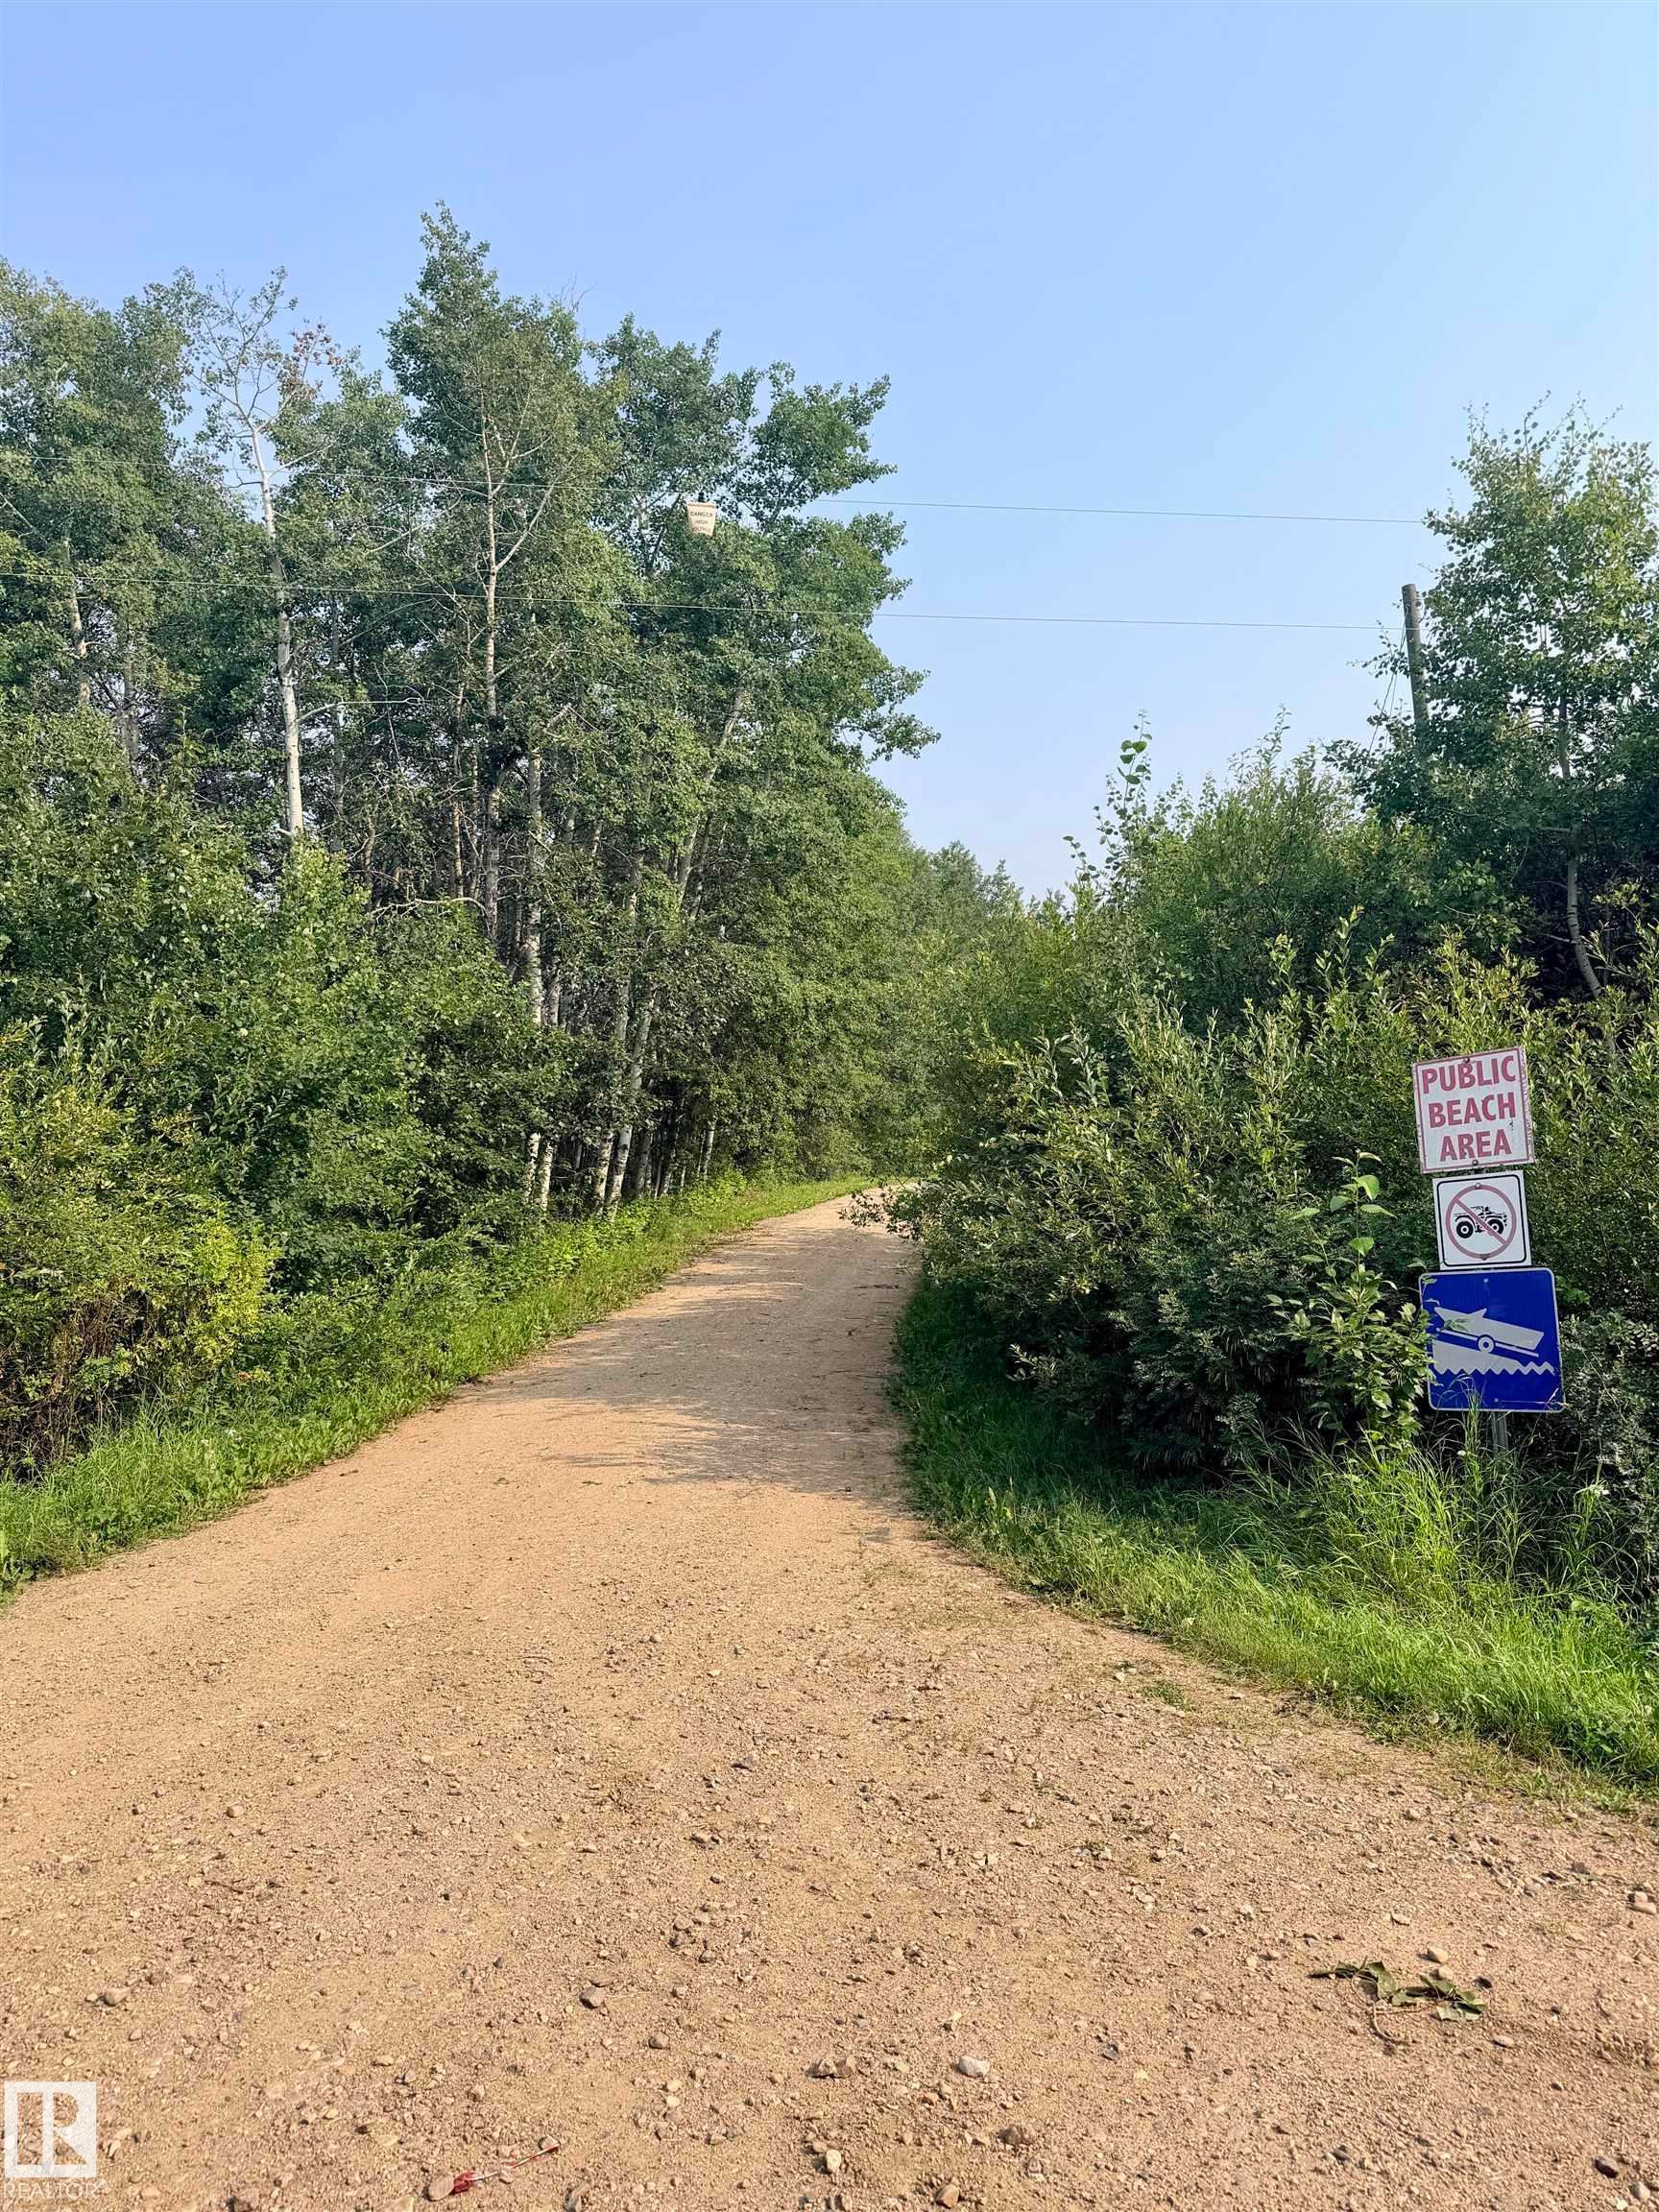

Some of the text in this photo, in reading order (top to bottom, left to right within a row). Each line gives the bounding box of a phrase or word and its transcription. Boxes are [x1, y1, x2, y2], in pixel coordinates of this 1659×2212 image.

[1421, 1055, 1516, 1094] PUBLIC
[1429, 1092, 1516, 1128] BEACH
[1440, 1129, 1512, 1162] AREA
